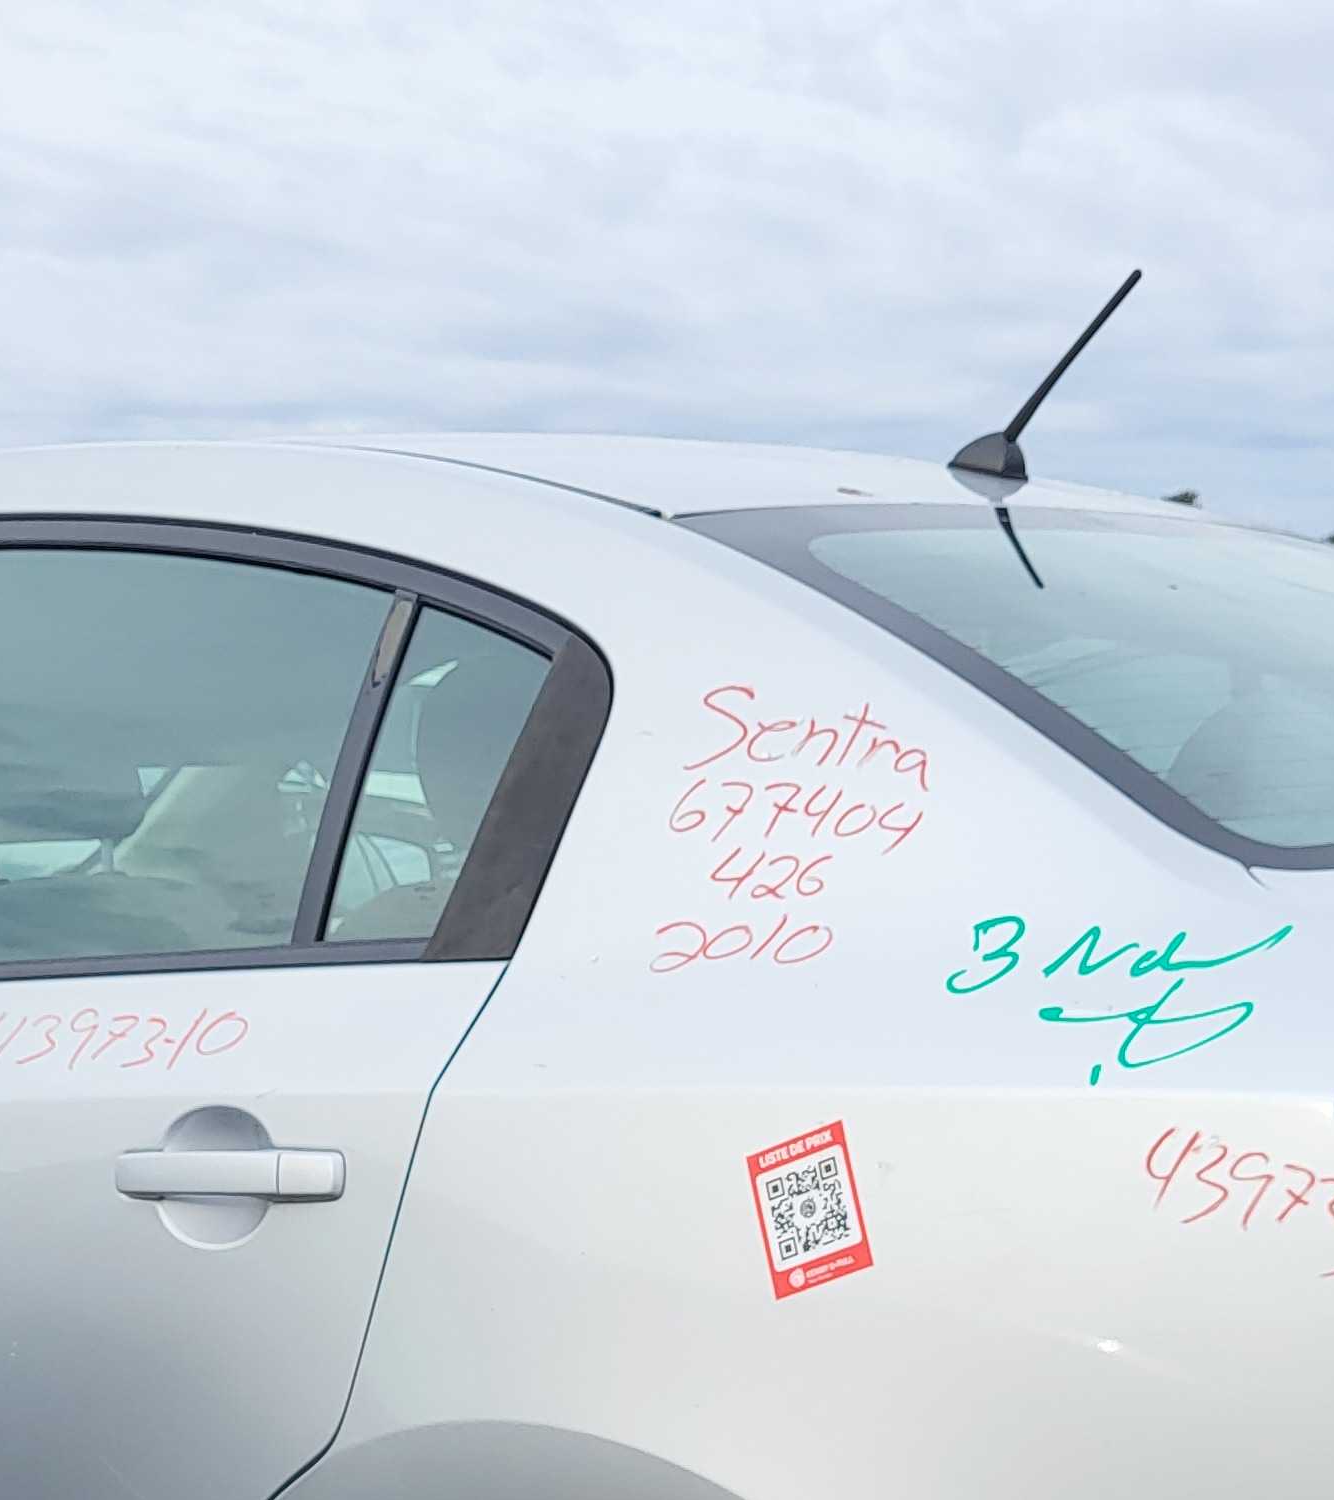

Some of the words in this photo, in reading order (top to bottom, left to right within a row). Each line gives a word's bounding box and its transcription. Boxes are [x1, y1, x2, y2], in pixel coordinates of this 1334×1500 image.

[683, 684, 929, 792] Sentra
[668, 778, 924, 856] 677404
[710, 847, 834, 900] 426
[649, 913, 834, 973] 2010
